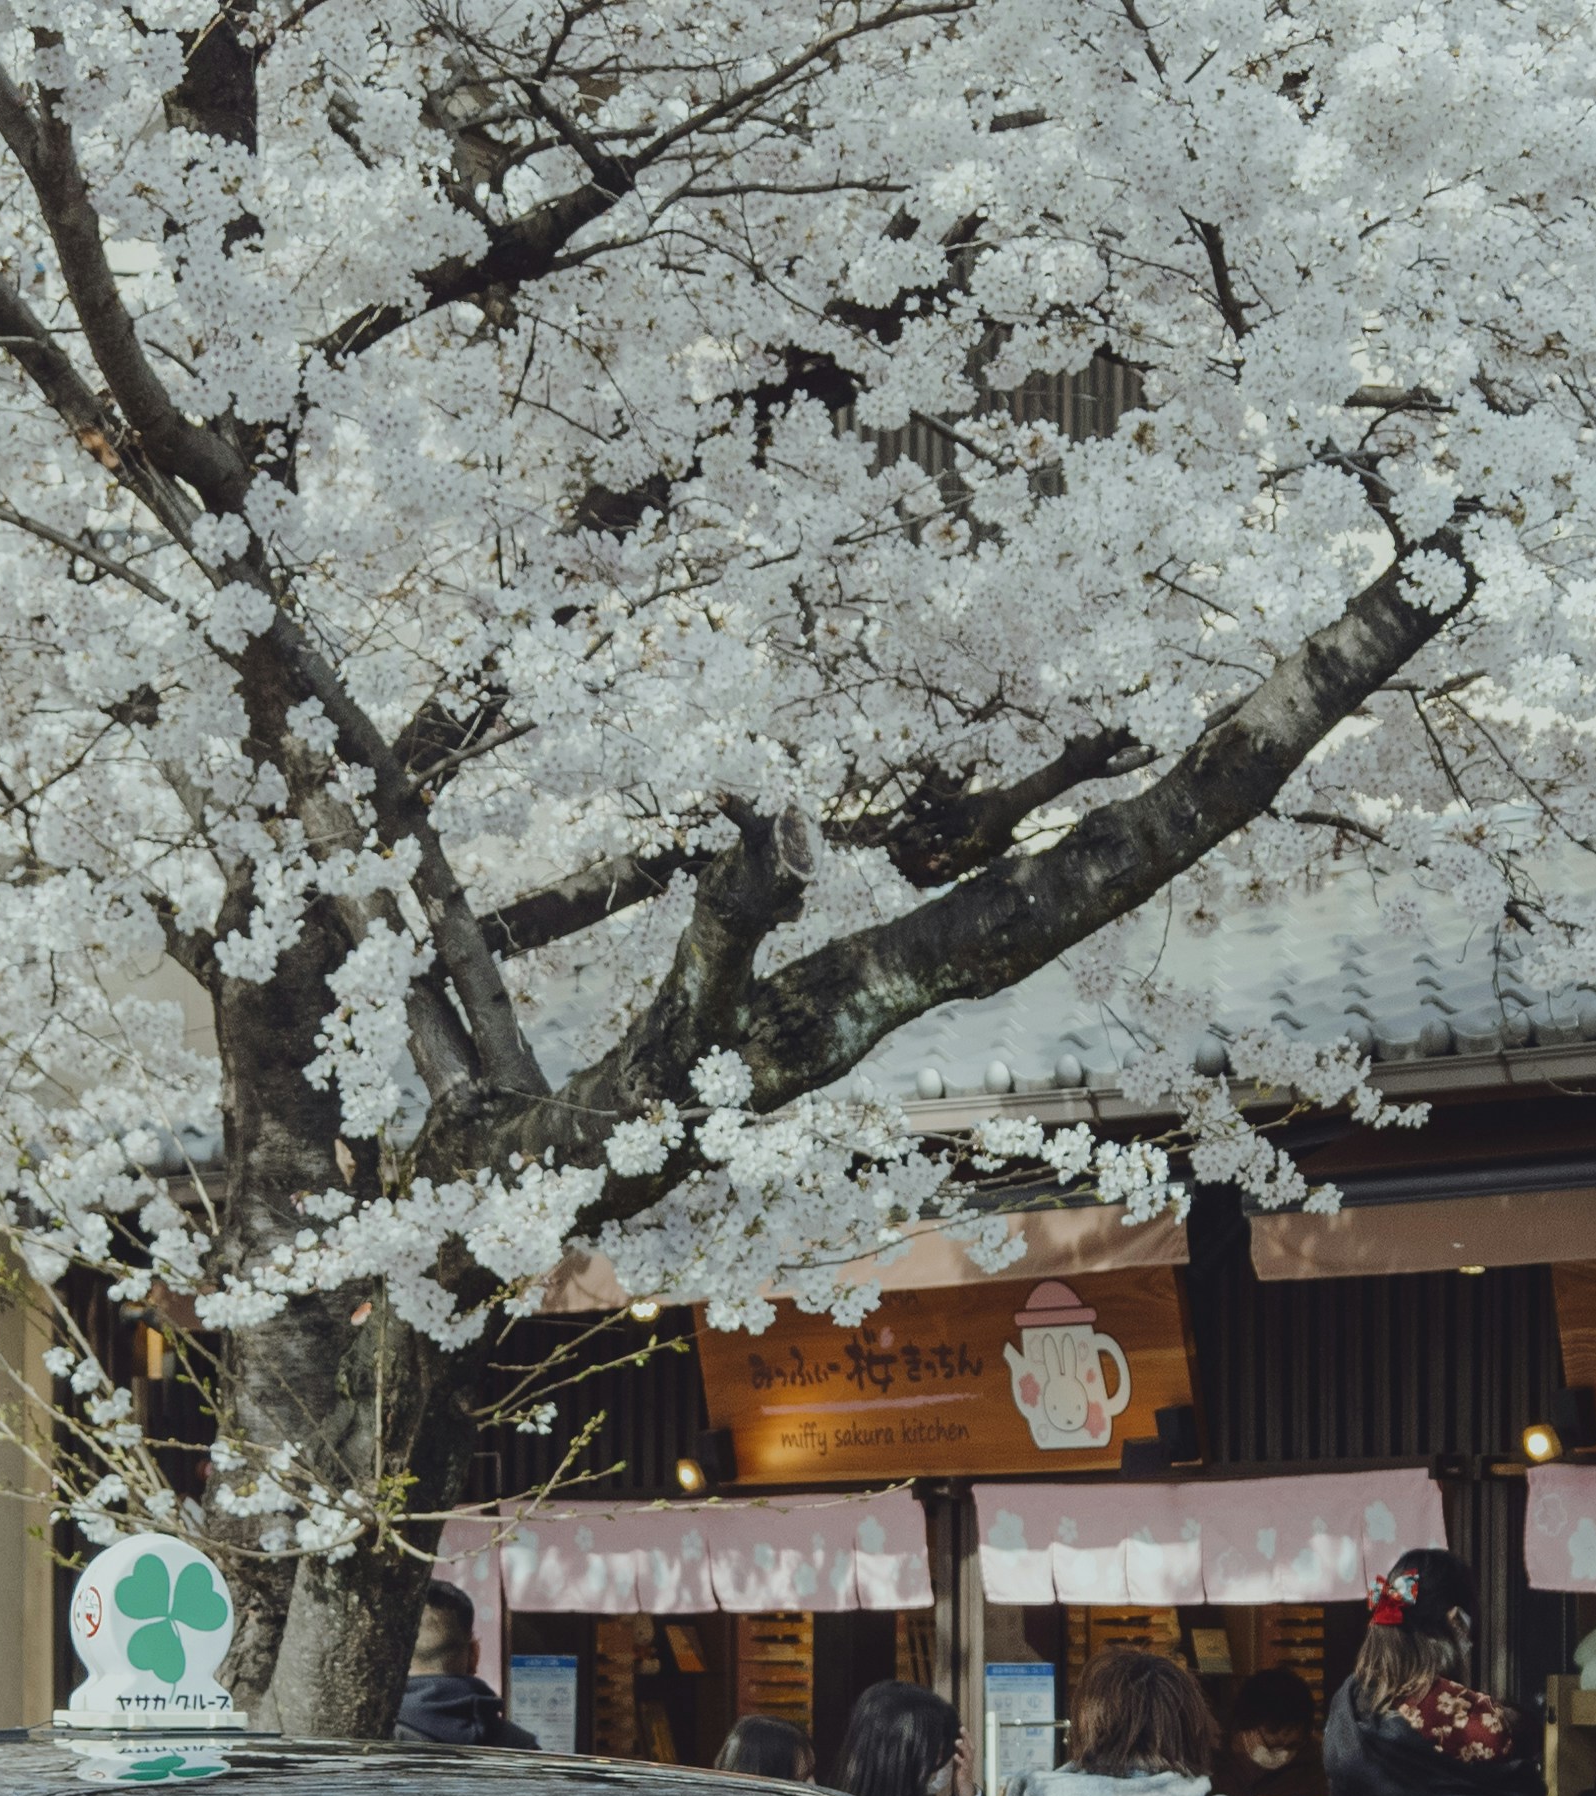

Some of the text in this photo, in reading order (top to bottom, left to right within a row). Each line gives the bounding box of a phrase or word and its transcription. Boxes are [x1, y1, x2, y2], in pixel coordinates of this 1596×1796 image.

[781, 1416, 971, 1456] miffy sakura kitchen
